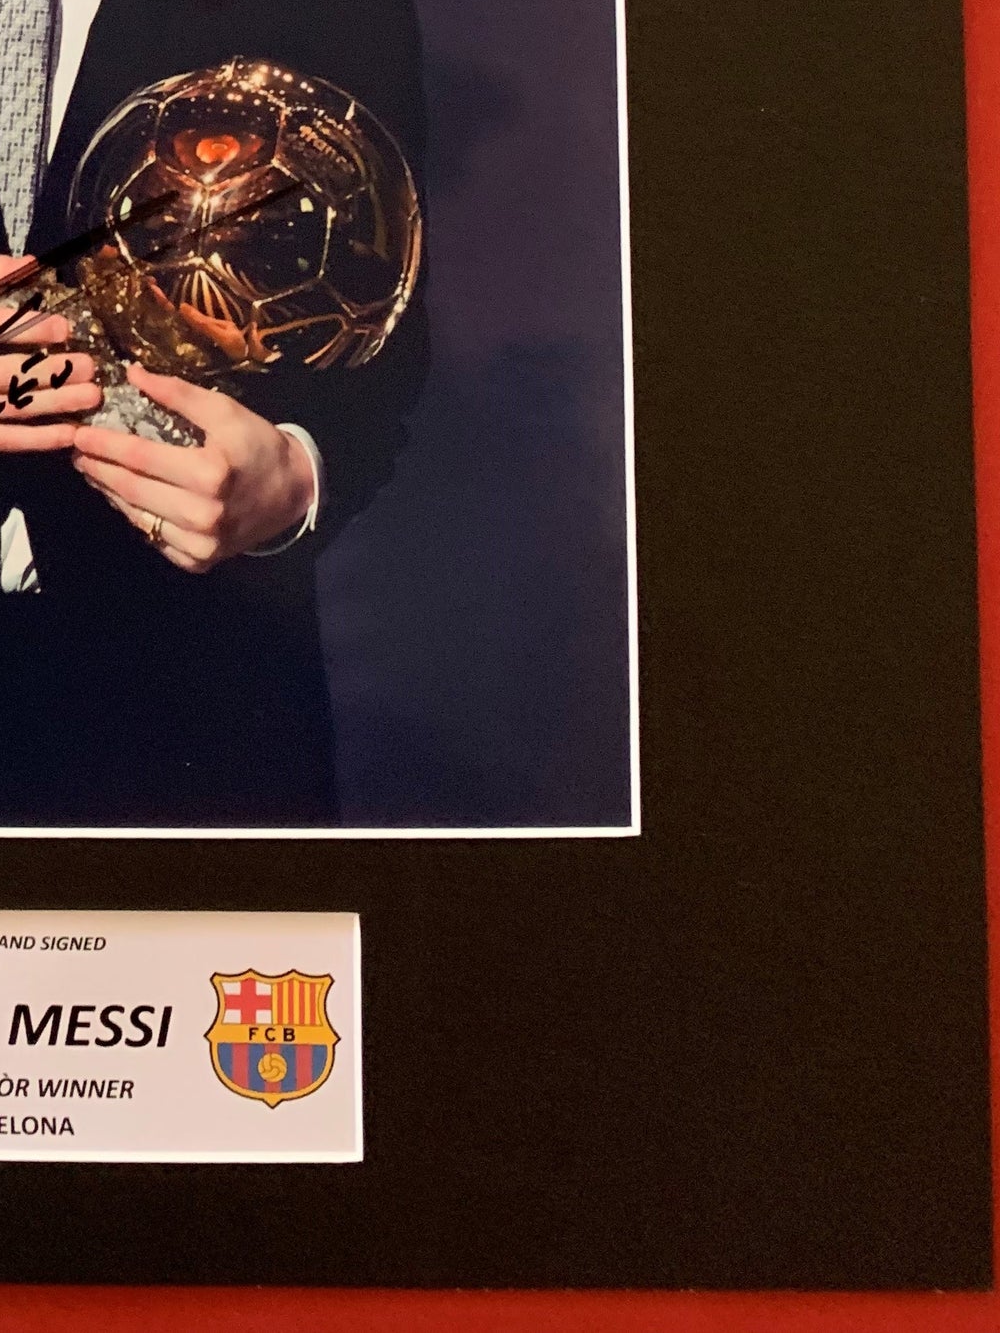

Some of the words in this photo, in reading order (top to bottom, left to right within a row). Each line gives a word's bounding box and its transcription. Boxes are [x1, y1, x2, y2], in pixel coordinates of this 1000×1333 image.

[40, 936, 107, 952] SIGNED
[7, 1003, 173, 1048] MESSI
[38, 1078, 135, 1100] WINNER
